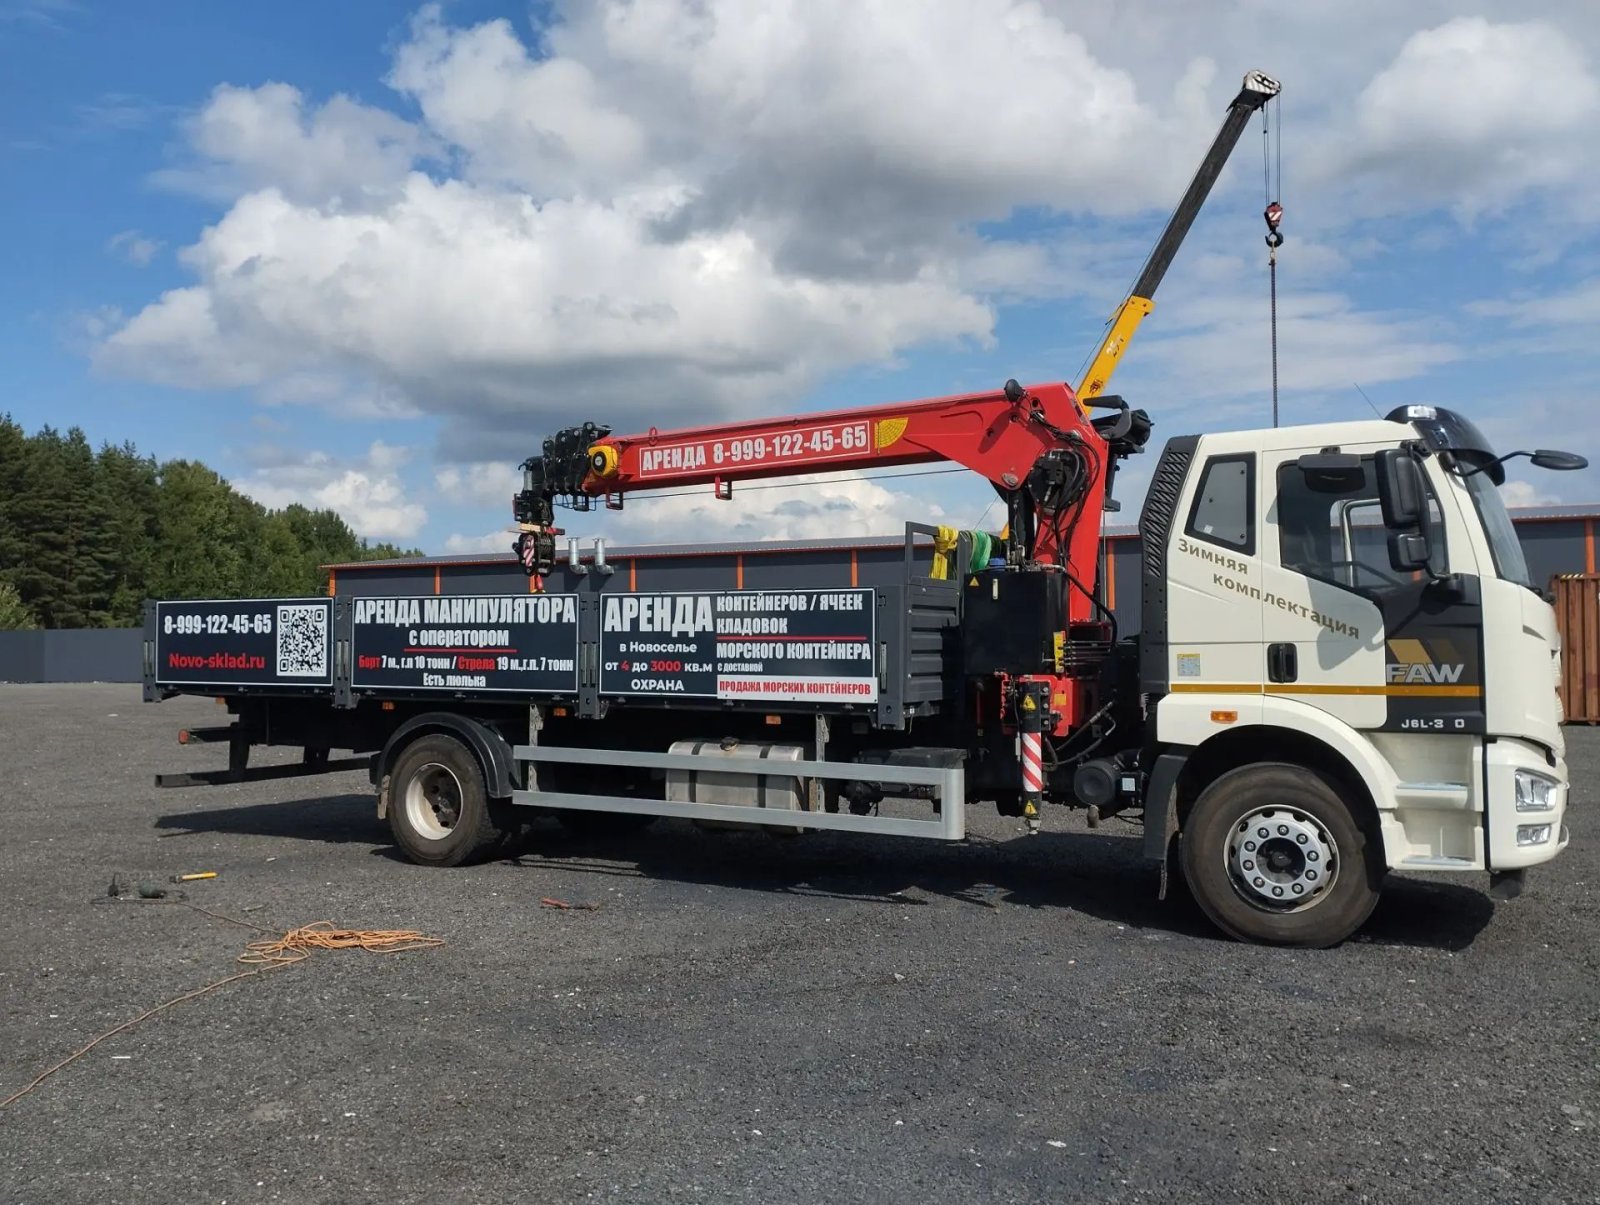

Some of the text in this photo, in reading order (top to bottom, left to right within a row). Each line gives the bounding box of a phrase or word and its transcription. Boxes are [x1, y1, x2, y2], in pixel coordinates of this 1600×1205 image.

[643, 425, 866, 471] АРЕНДА 8-999-122-45-65
[1178, 538, 1248, 574] Зимняя
[716, 592, 862, 612] КОНТЕЙНЕРОВ / ЯЧЕЕК
[1213, 573, 1359, 640] комплектация
[355, 597, 576, 627] АРЕНДА МАНИПУЛЯТОРА
[604, 596, 714, 638] АРЕНДА
[164, 614, 272, 634] 8-999-122-45-65
[716, 617, 788, 636] КЛАДОВОК
[420, 629, 509, 648] оператором
[620, 642, 698, 653] в Новоселье
[716, 640, 871, 661] МОРСКОГО КОНТЕЙНЕРА
[168, 652, 266, 670] Novo-sklad.ru
[358, 655, 380, 669] Борт
[382, 655, 387, 668] 7
[414, 656, 426, 669] 10
[426, 658, 450, 670] тонн
[452, 656, 457, 670] /
[458, 656, 495, 671] Стрела
[496, 656, 508, 670] 19
[540, 657, 546, 671] 7
[548, 659, 574, 672] тонн
[605, 660, 712, 673] от 4 до 3000 кв.м
[422, 672, 486, 688] Есть люлька
[1386, 663, 1464, 684] FAW
[631, 679, 684, 692] ОХРАНА
[719, 680, 871, 696] ПРОДАЖА МОРСКИХ КОНТЕЙНЕРОВ
